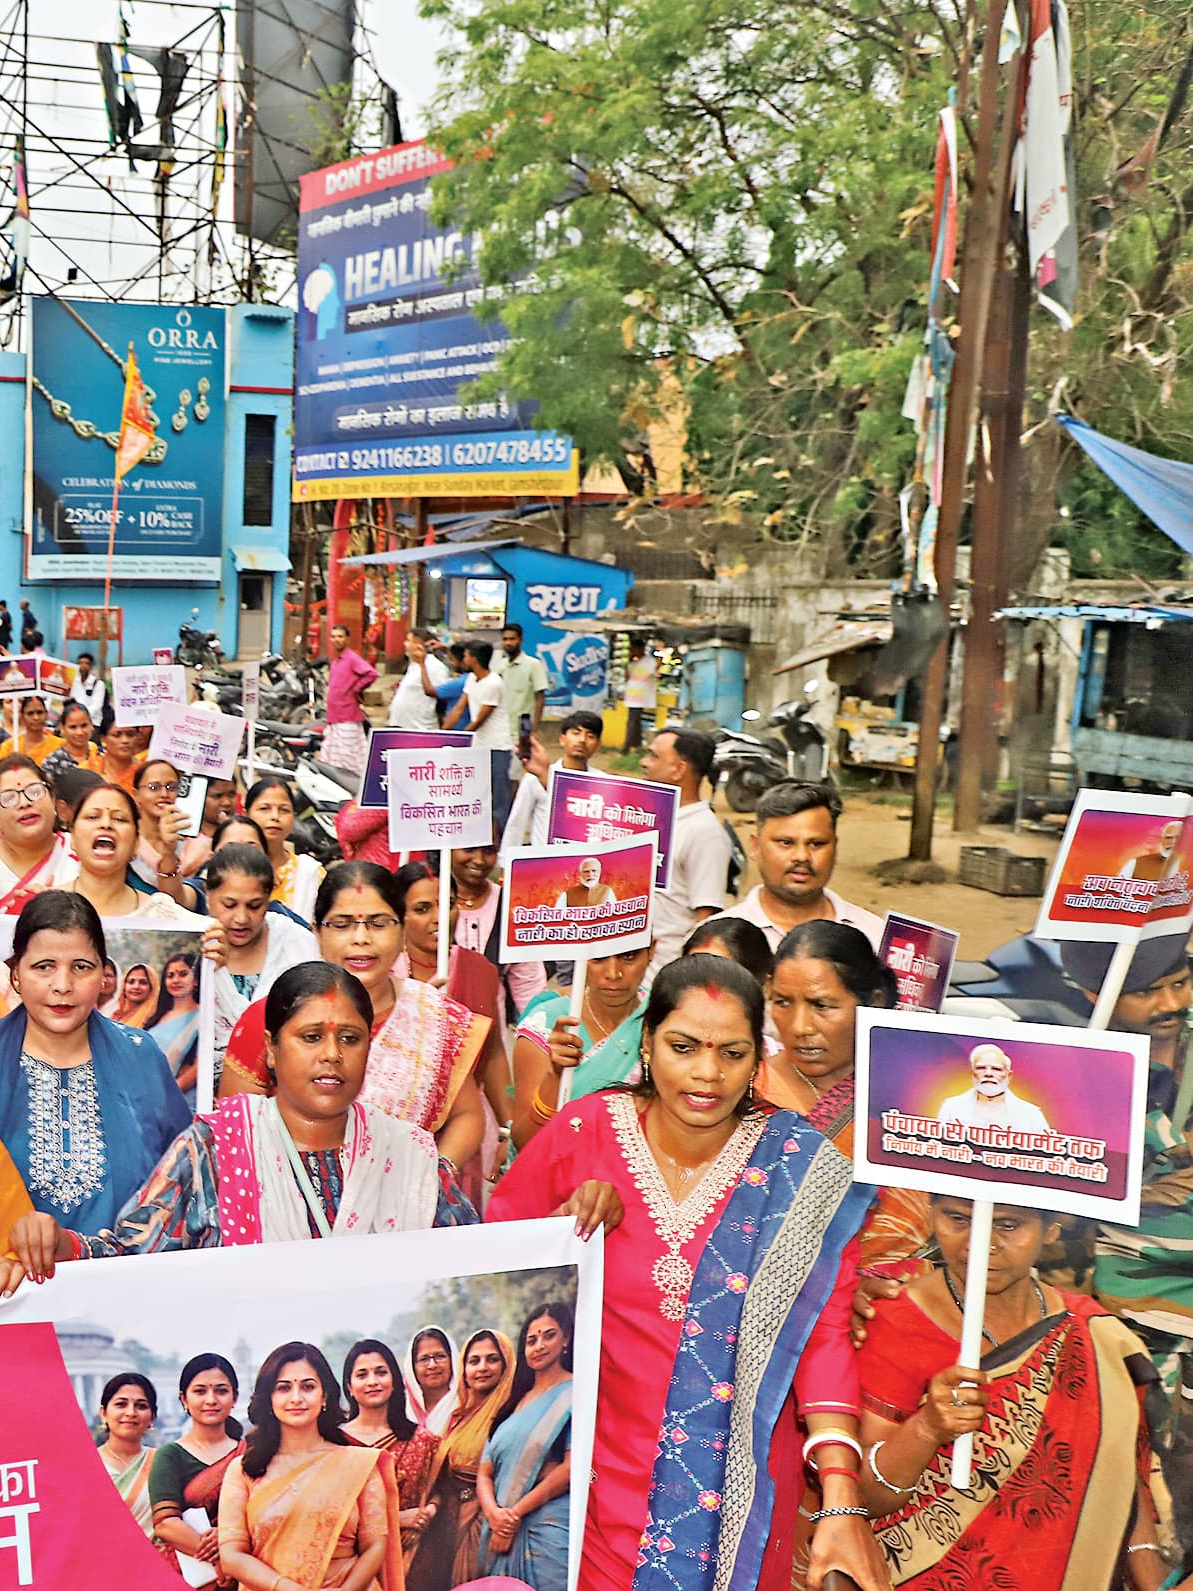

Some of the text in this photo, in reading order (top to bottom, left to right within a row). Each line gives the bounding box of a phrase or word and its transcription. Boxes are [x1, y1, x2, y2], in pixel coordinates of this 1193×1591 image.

[325, 160, 375, 196] DON'T
[344, 231, 464, 302] HEALING
[147, 327, 218, 350] ORRA
[351, 444, 442, 470] 9241166238
[452, 438, 567, 466] 6207478455
[62, 477, 129, 489] CELEBRATIN
[139, 511, 170, 529] 10%
[526, 583, 602, 619] सुधा
[198, 742, 220, 757] नारी
[407, 760, 476, 781] नारी शक्ति का
[400, 799, 482, 820] विकसित भारत की
[566, 793, 657, 828] नारी को मिलेगा
[428, 821, 463, 837] पहचान
[1083, 874, 1109, 891] अब
[514, 896, 648, 923] विकसित भारत की पहचान
[1065, 893, 1093, 908] नारी
[1092, 894, 1121, 910] शक्ति
[516, 915, 646, 942] नारी का हो सशक्त स्थान
[887, 943, 915, 973] नारी
[884, 1110, 1106, 1160] पंचायत से पार्लियामेंट तक
[884, 1134, 924, 1155] निर्णय
[925, 1139, 940, 1158] में
[940, 1144, 972, 1163] नारी
[983, 1152, 1007, 1168] नव
[1008, 1155, 1047, 1173] भारत
[1047, 1156, 1067, 1175] की
[1067, 1157, 1108, 1182] तैयारी
